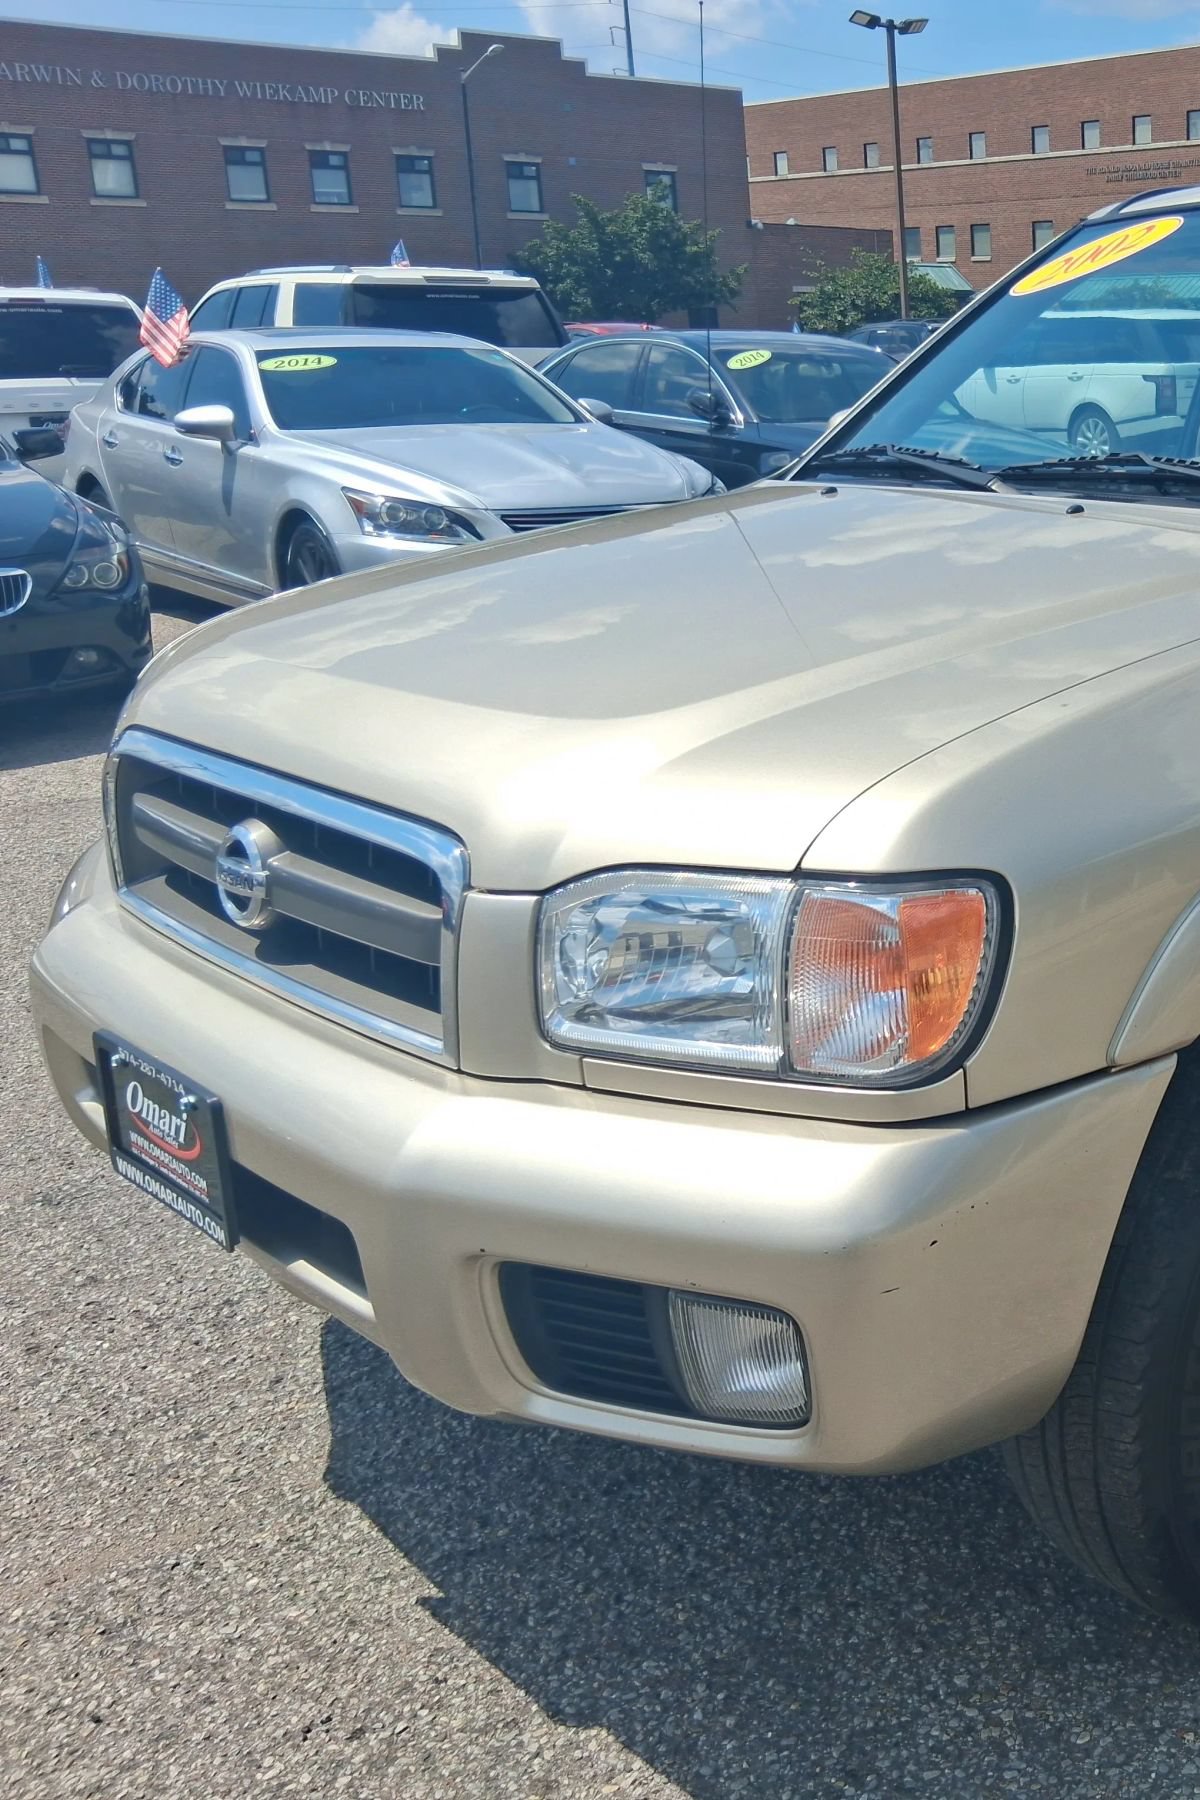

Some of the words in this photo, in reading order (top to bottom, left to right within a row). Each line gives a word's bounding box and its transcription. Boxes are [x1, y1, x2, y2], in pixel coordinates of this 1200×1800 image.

[90, 70, 107, 89] &
[115, 71, 229, 97] DOROTHY
[233, 80, 339, 105] WIEKAMP
[344, 89, 426, 111] CENTER
[1032, 224, 1156, 288] 2002
[273, 356, 322, 369] 2014
[735, 351, 766, 367] 2014
[126, 1081, 188, 1144] Omari
[116, 1156, 226, 1246] WWW.OMARIAUTO.COM
